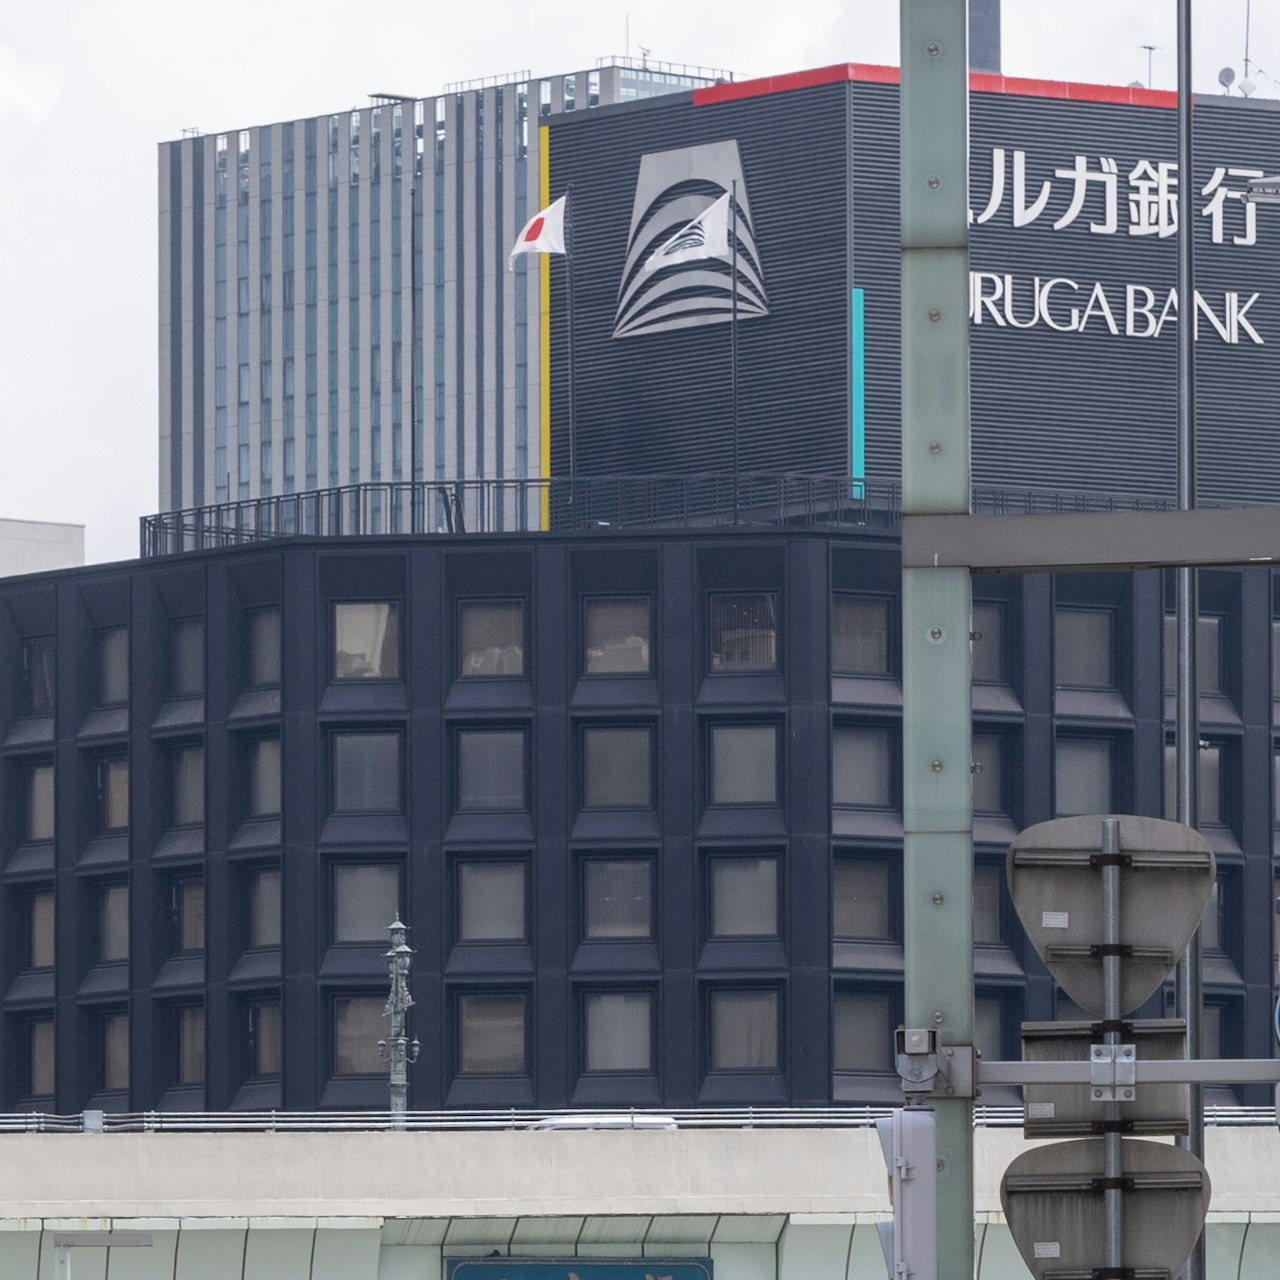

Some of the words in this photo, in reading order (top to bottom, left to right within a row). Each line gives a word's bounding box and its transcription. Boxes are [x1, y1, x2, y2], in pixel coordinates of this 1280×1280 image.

[969, 147, 1266, 246] ルガ銀行
[969, 271, 1120, 336] RUGA
[1125, 283, 1266, 344] BANK
